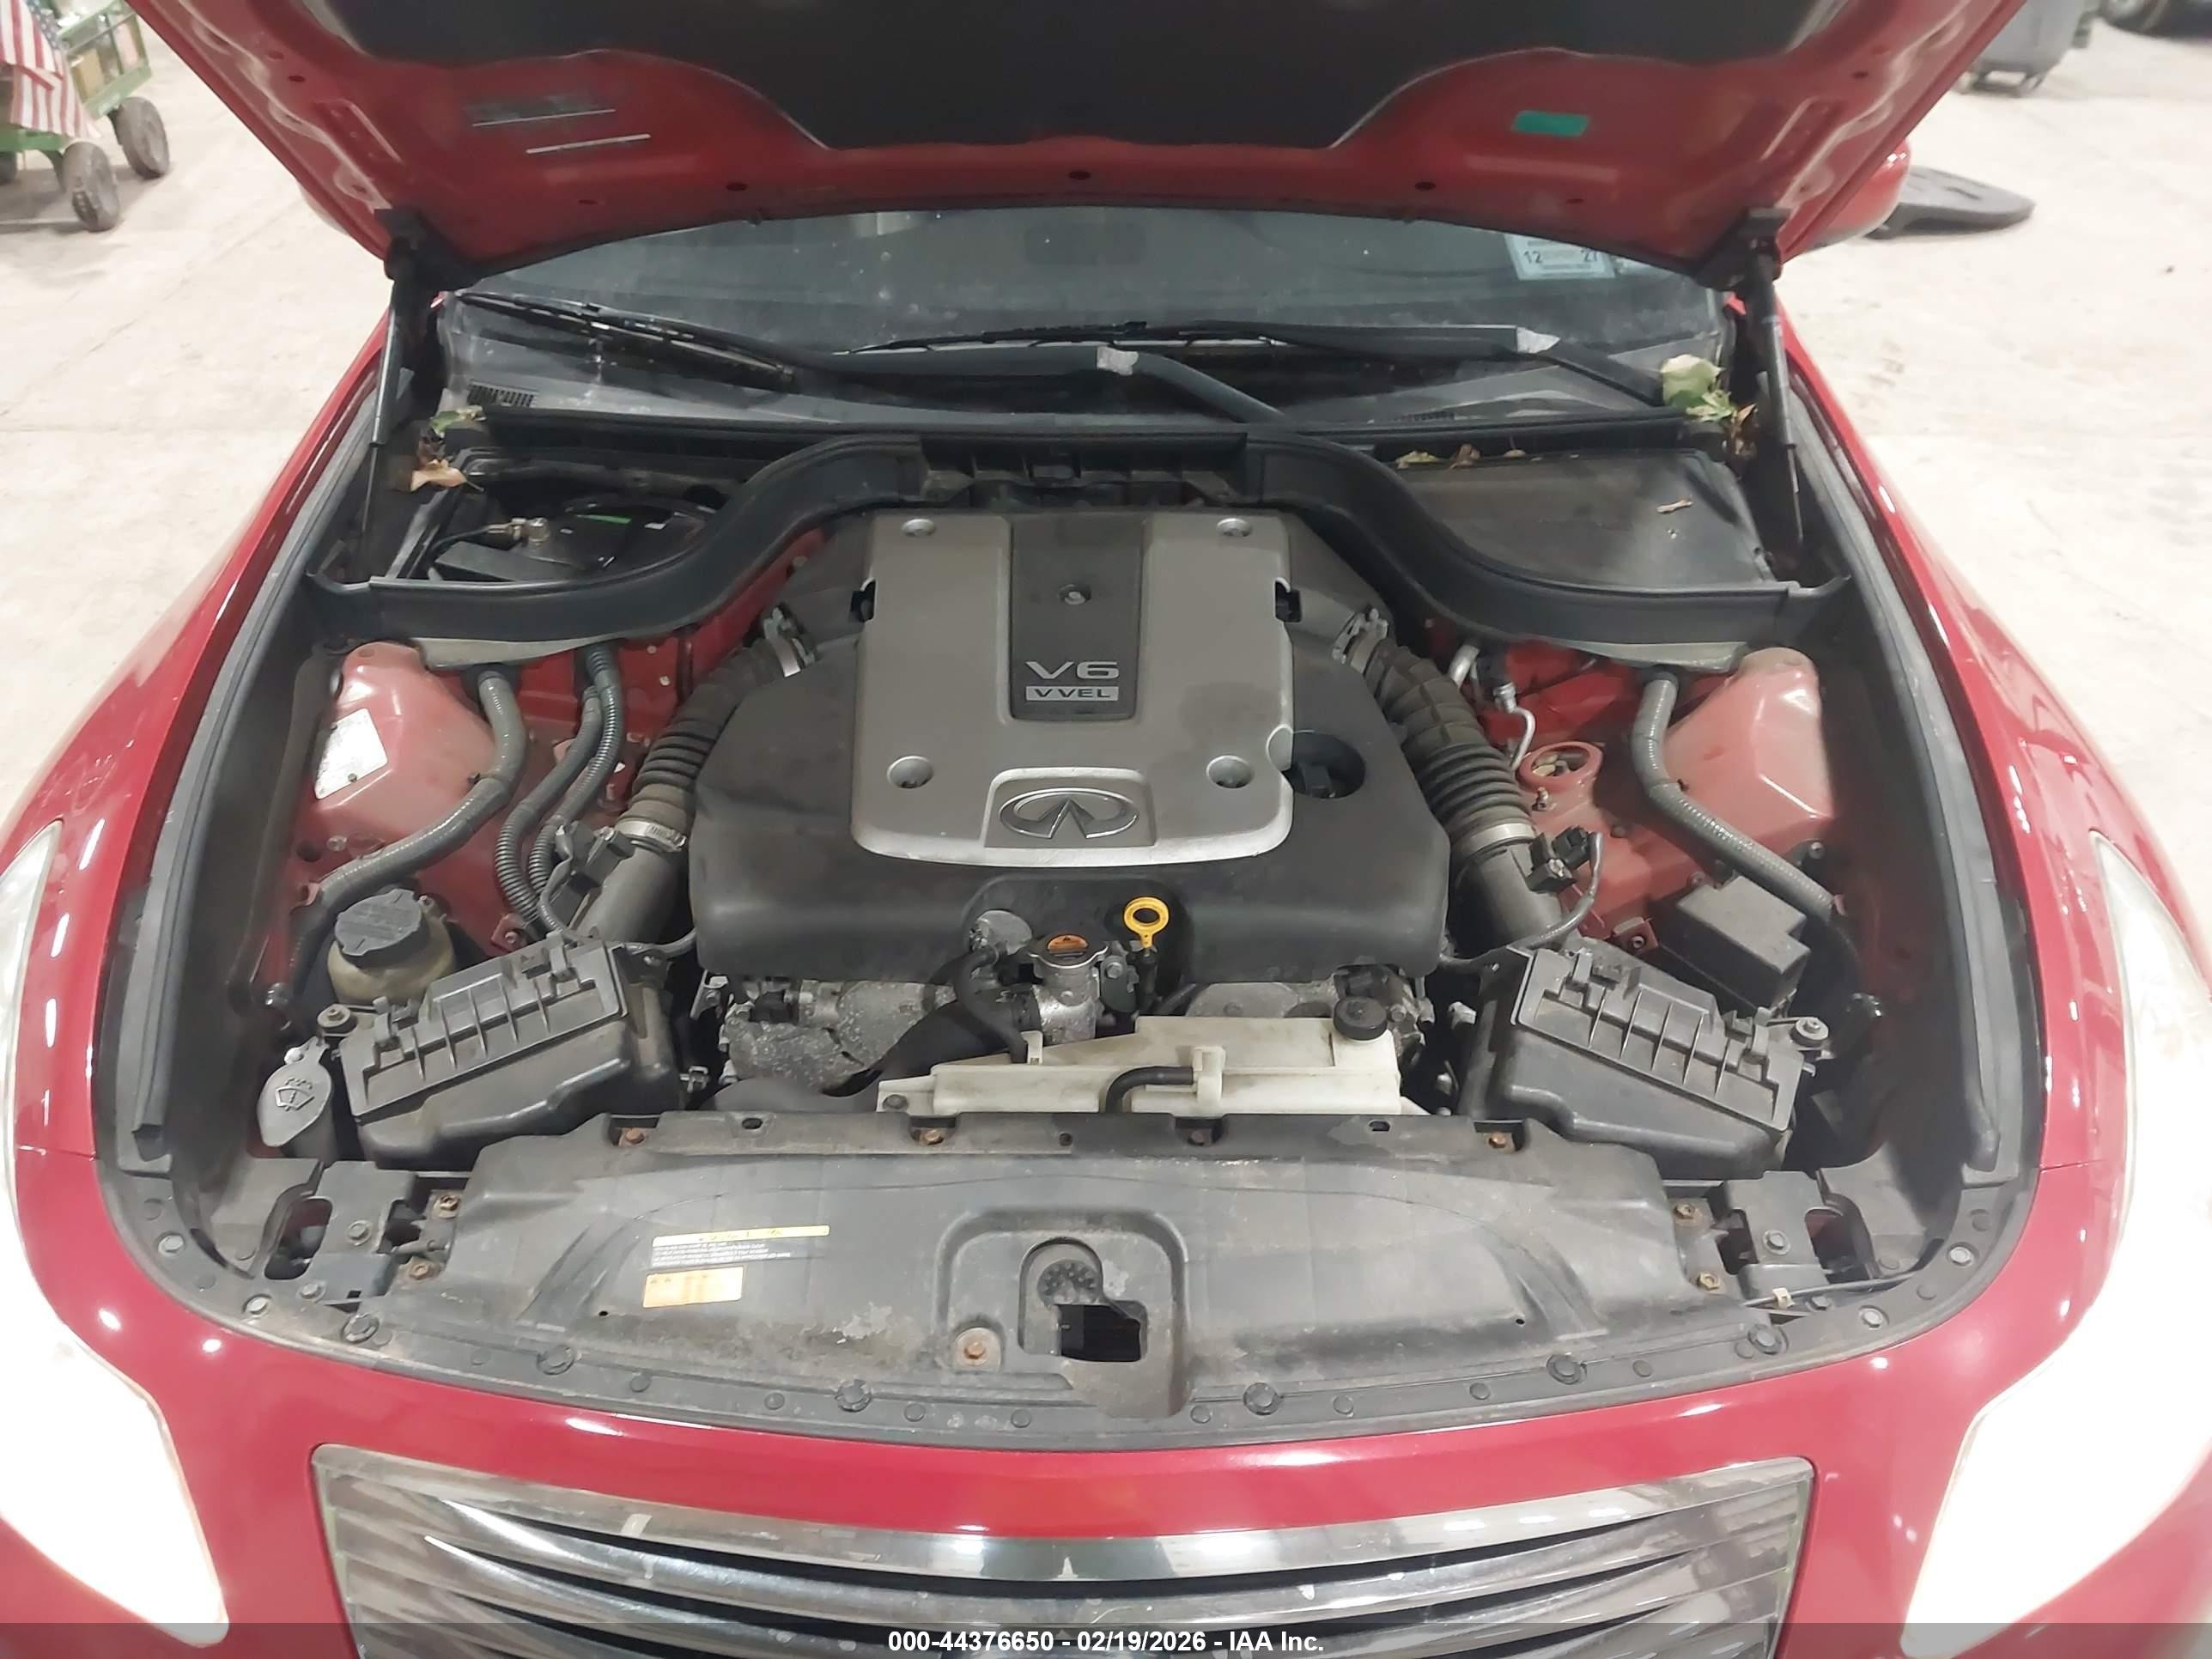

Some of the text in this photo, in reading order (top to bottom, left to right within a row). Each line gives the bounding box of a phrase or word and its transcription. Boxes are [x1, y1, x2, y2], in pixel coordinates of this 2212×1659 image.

[1523, 250, 1543, 264] 12
[1024, 660, 1120, 680] V6
[1034, 688, 1111, 698] VVEL
